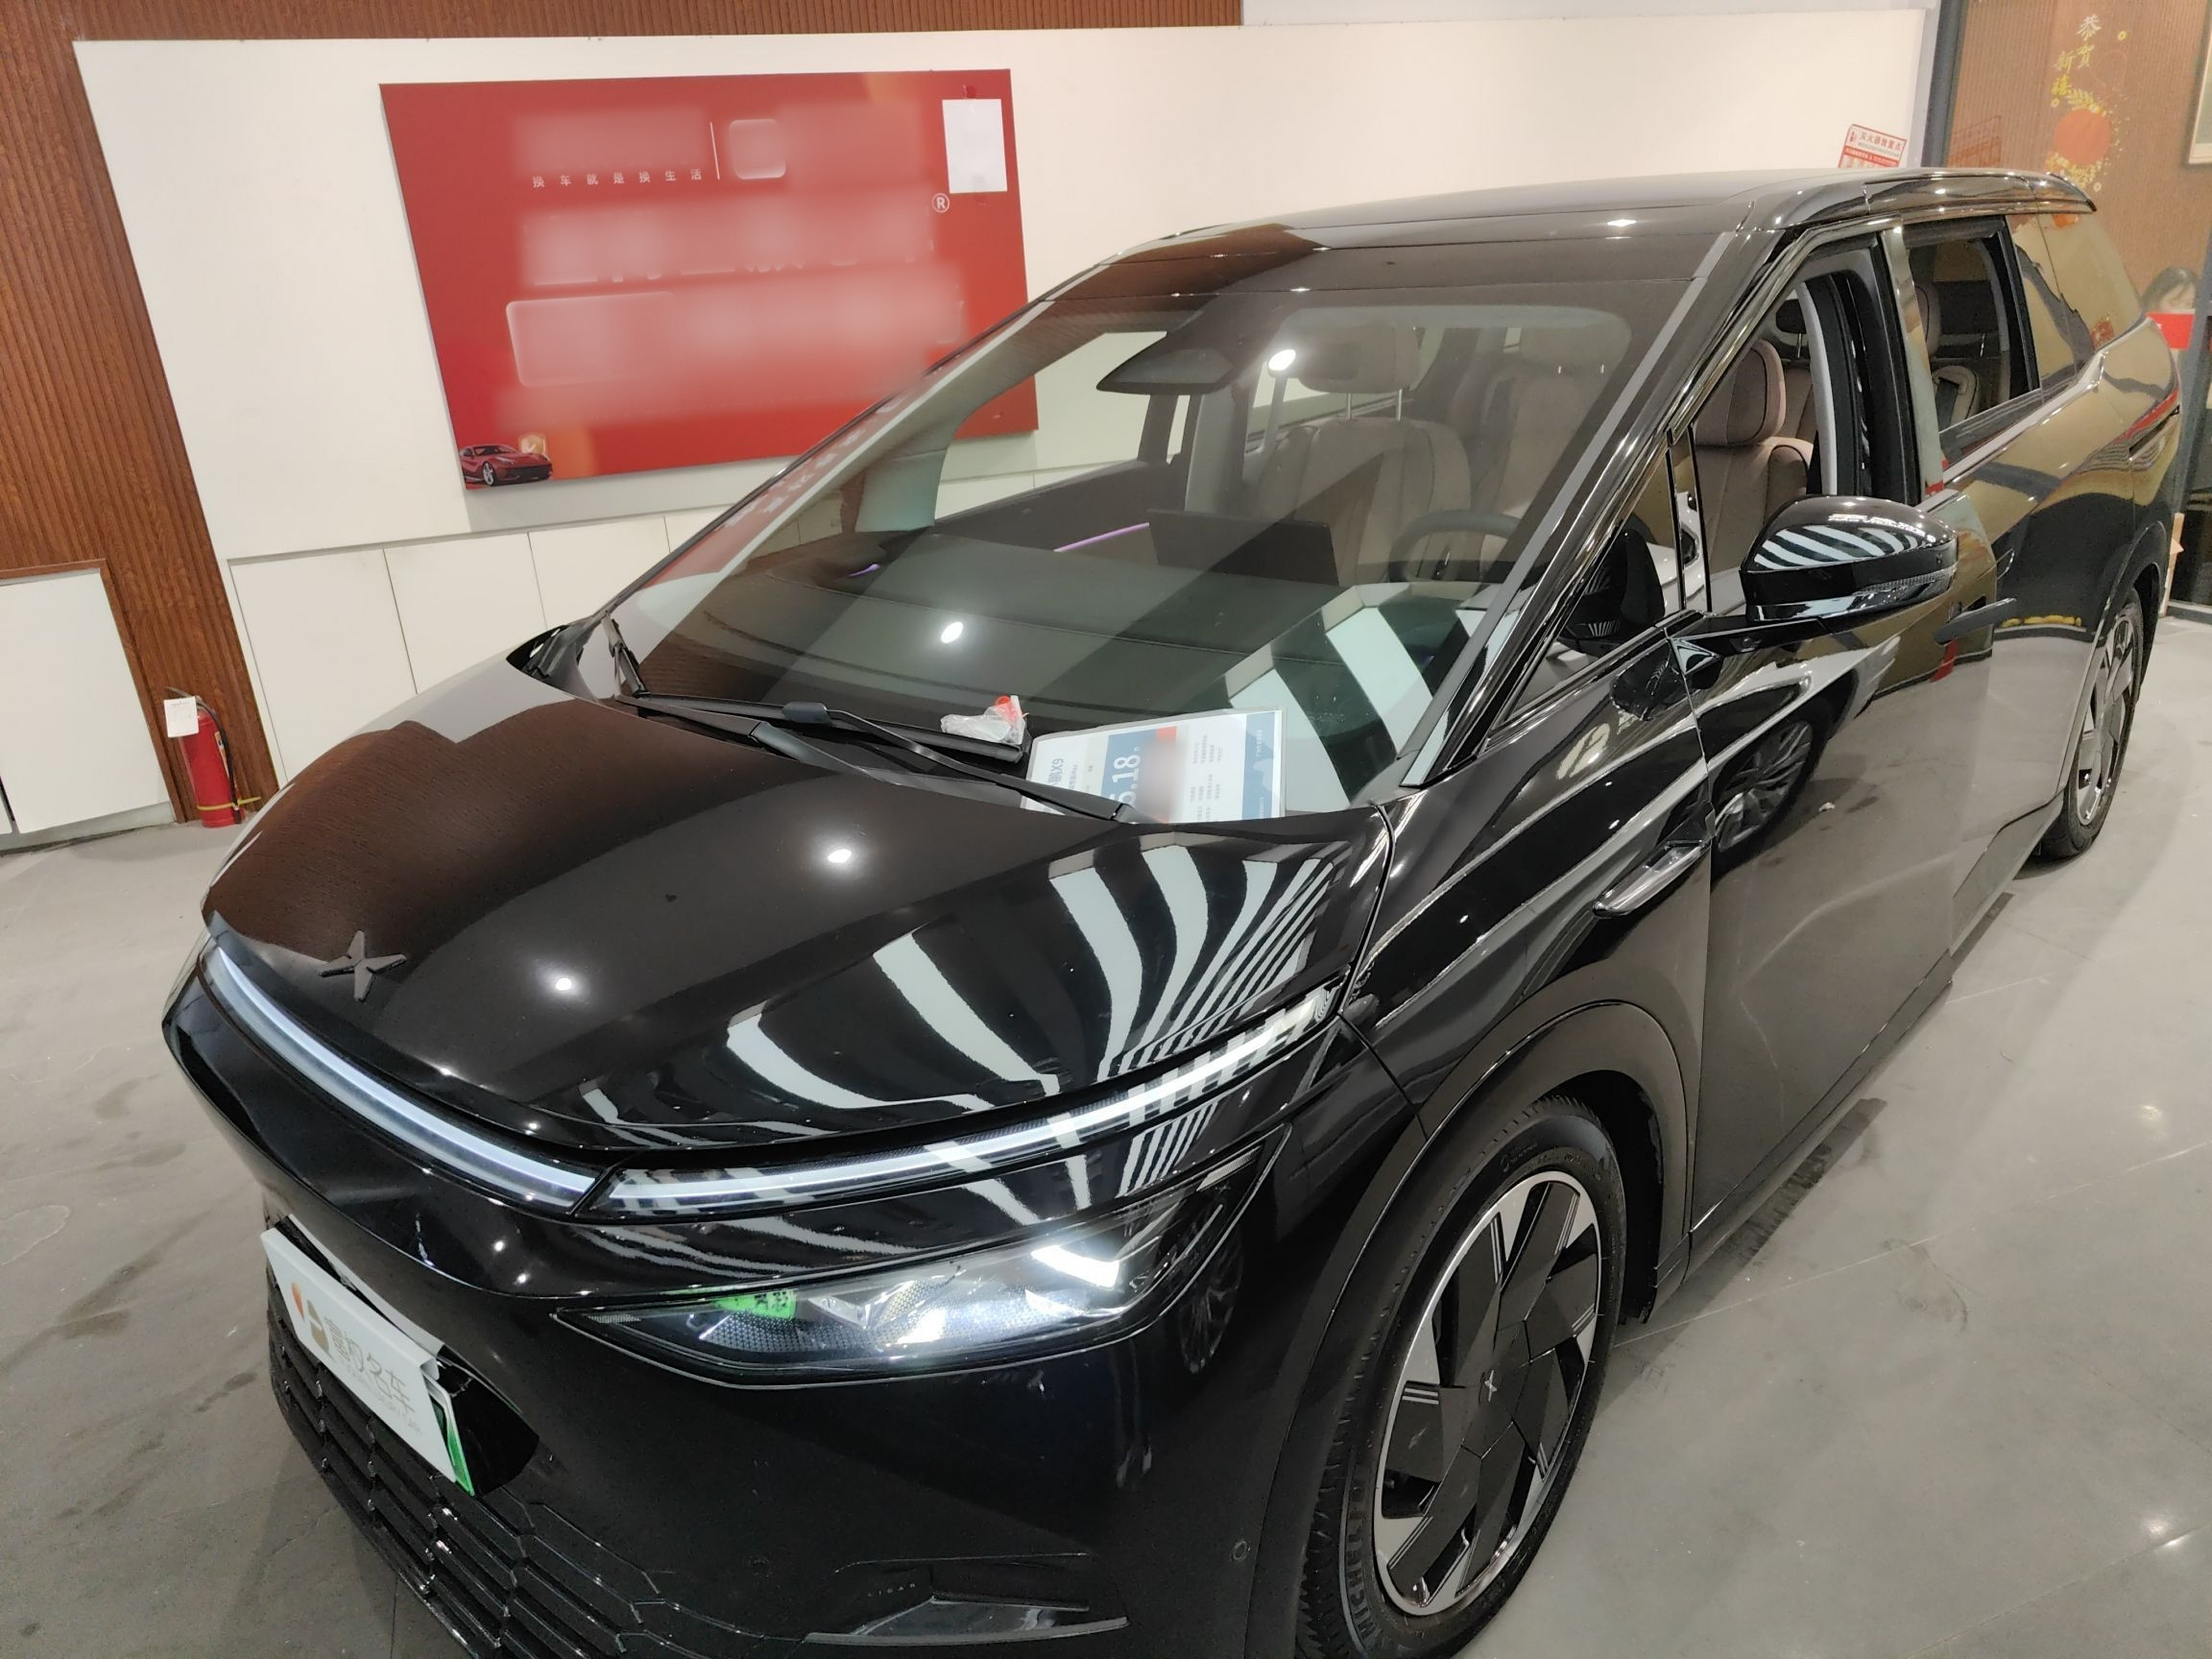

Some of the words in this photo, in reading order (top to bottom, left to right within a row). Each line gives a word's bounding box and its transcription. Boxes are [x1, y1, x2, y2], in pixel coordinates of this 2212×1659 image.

[532, 169, 702, 188] 换车就是换生活
[1048, 758, 1064, 786] 鹏X9
